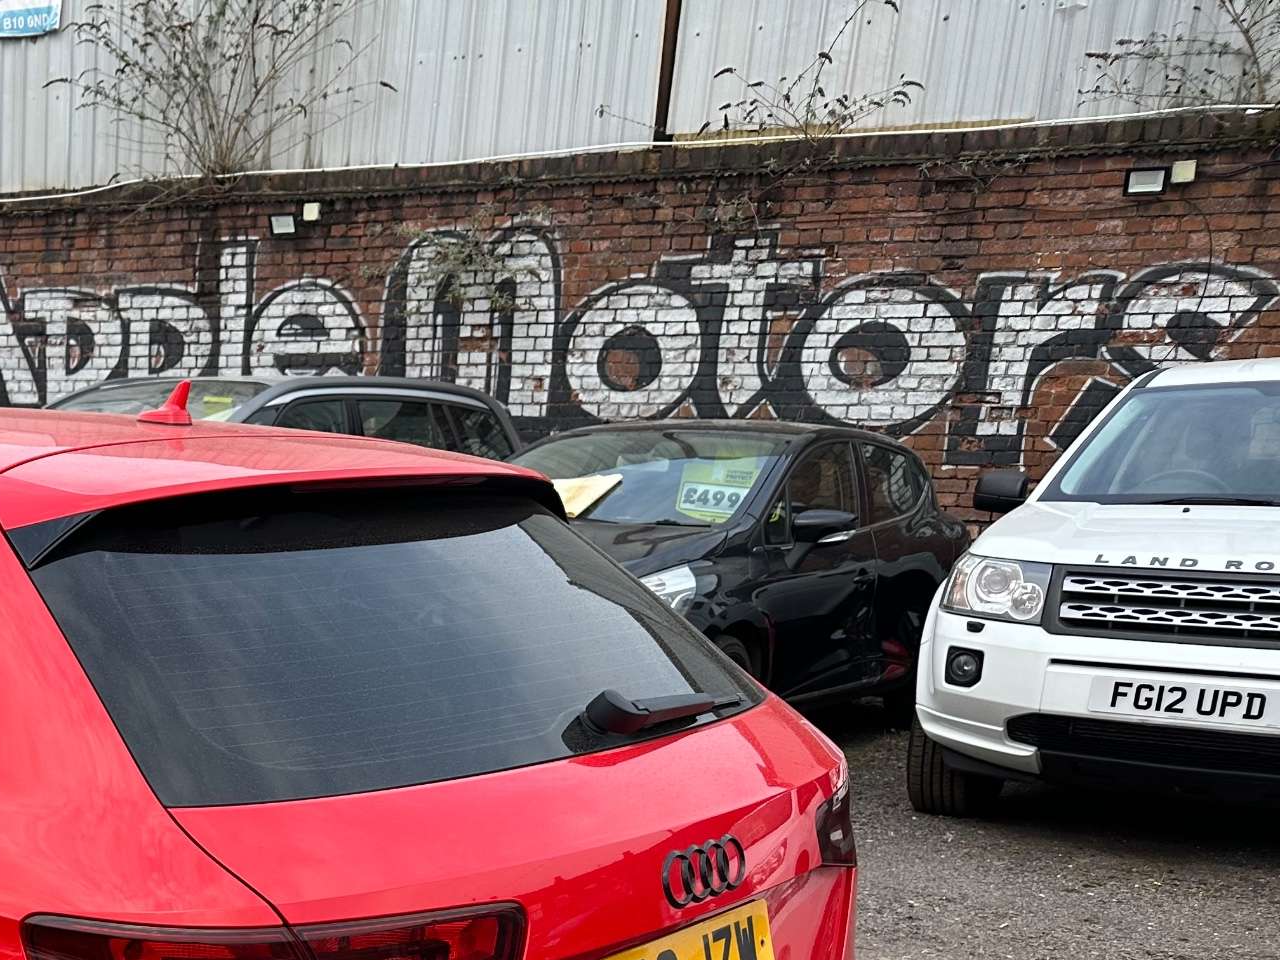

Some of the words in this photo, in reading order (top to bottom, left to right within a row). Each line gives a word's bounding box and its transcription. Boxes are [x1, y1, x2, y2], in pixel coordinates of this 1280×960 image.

[2, 16, 25, 31] B10
[380, 217, 1277, 468] Motors
[1094, 554, 1199, 568] LAND
[1109, 681, 1188, 714] FG12
[1195, 688, 1267, 721] UPD
